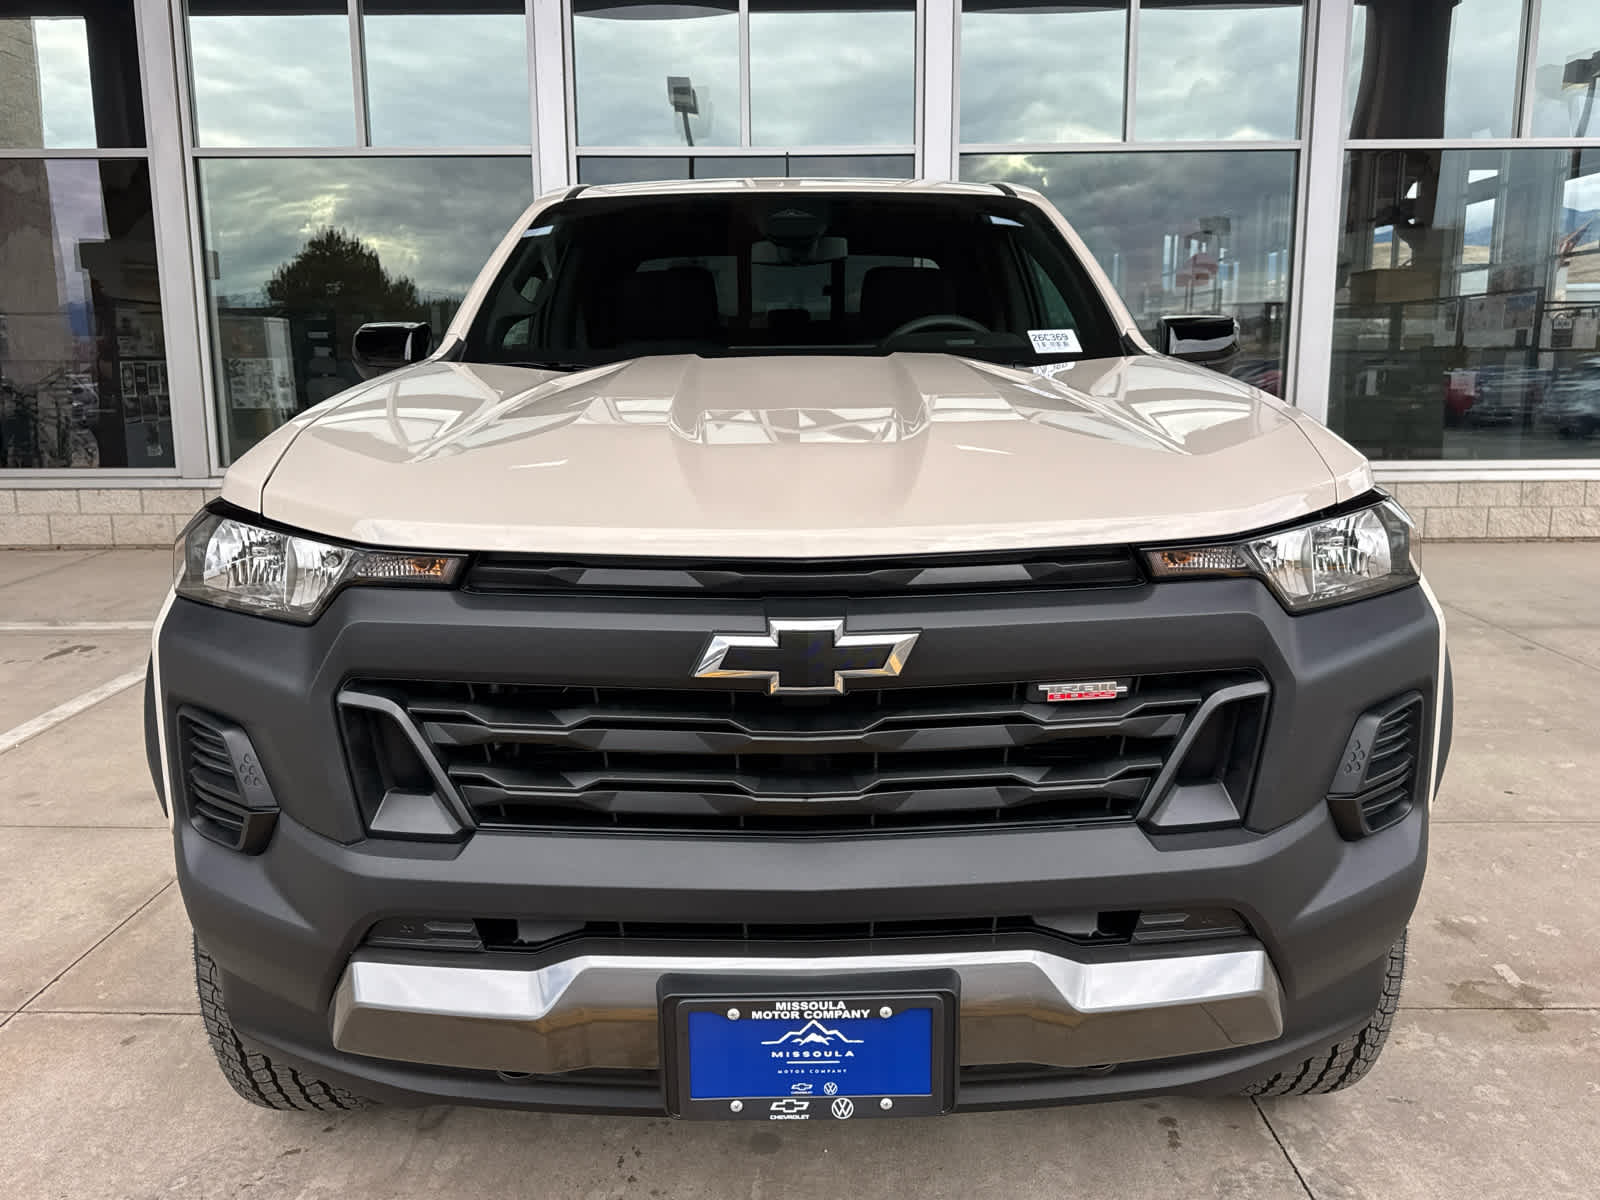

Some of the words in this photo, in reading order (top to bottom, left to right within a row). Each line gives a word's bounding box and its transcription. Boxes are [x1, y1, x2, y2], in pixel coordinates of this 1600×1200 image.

[775, 1001, 846, 1010] MISSOULA
[751, 1010, 801, 1019] MOTOR
[803, 1009, 870, 1019] COMPANY
[770, 1050, 855, 1058] MISSOULA
